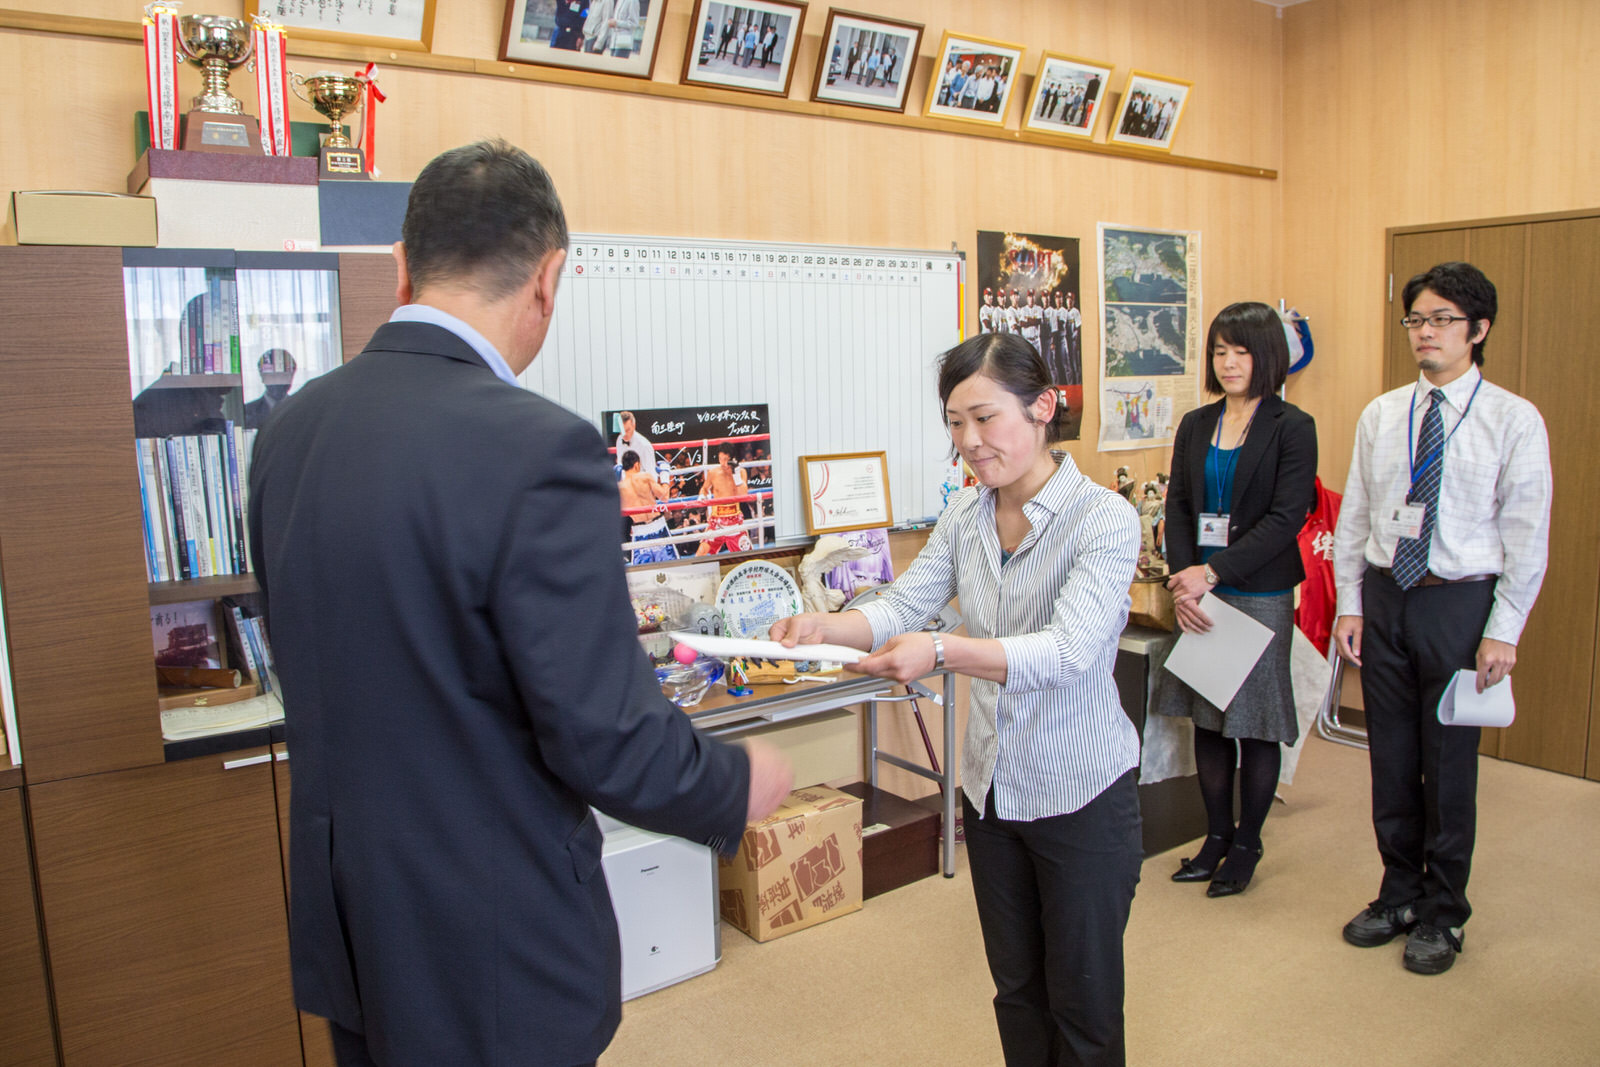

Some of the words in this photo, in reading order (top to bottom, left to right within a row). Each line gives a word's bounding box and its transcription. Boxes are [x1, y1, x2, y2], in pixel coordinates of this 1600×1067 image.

[576, 248, 582, 256] 6
[592, 248, 598, 256] 7
[608, 248, 614, 257] 8
[624, 249, 630, 258] 9
[638, 250, 647, 258] 10
[652, 250, 660, 258] 11
[668, 250, 676, 259] 12
[682, 251, 691, 260] 13
[696, 252, 705, 260] 14
[711, 252, 720, 260] 15
[725, 253, 734, 261] 16
[752, 254, 760, 262] 18
[778, 255, 787, 263] 20
[804, 256, 812, 264] 22
